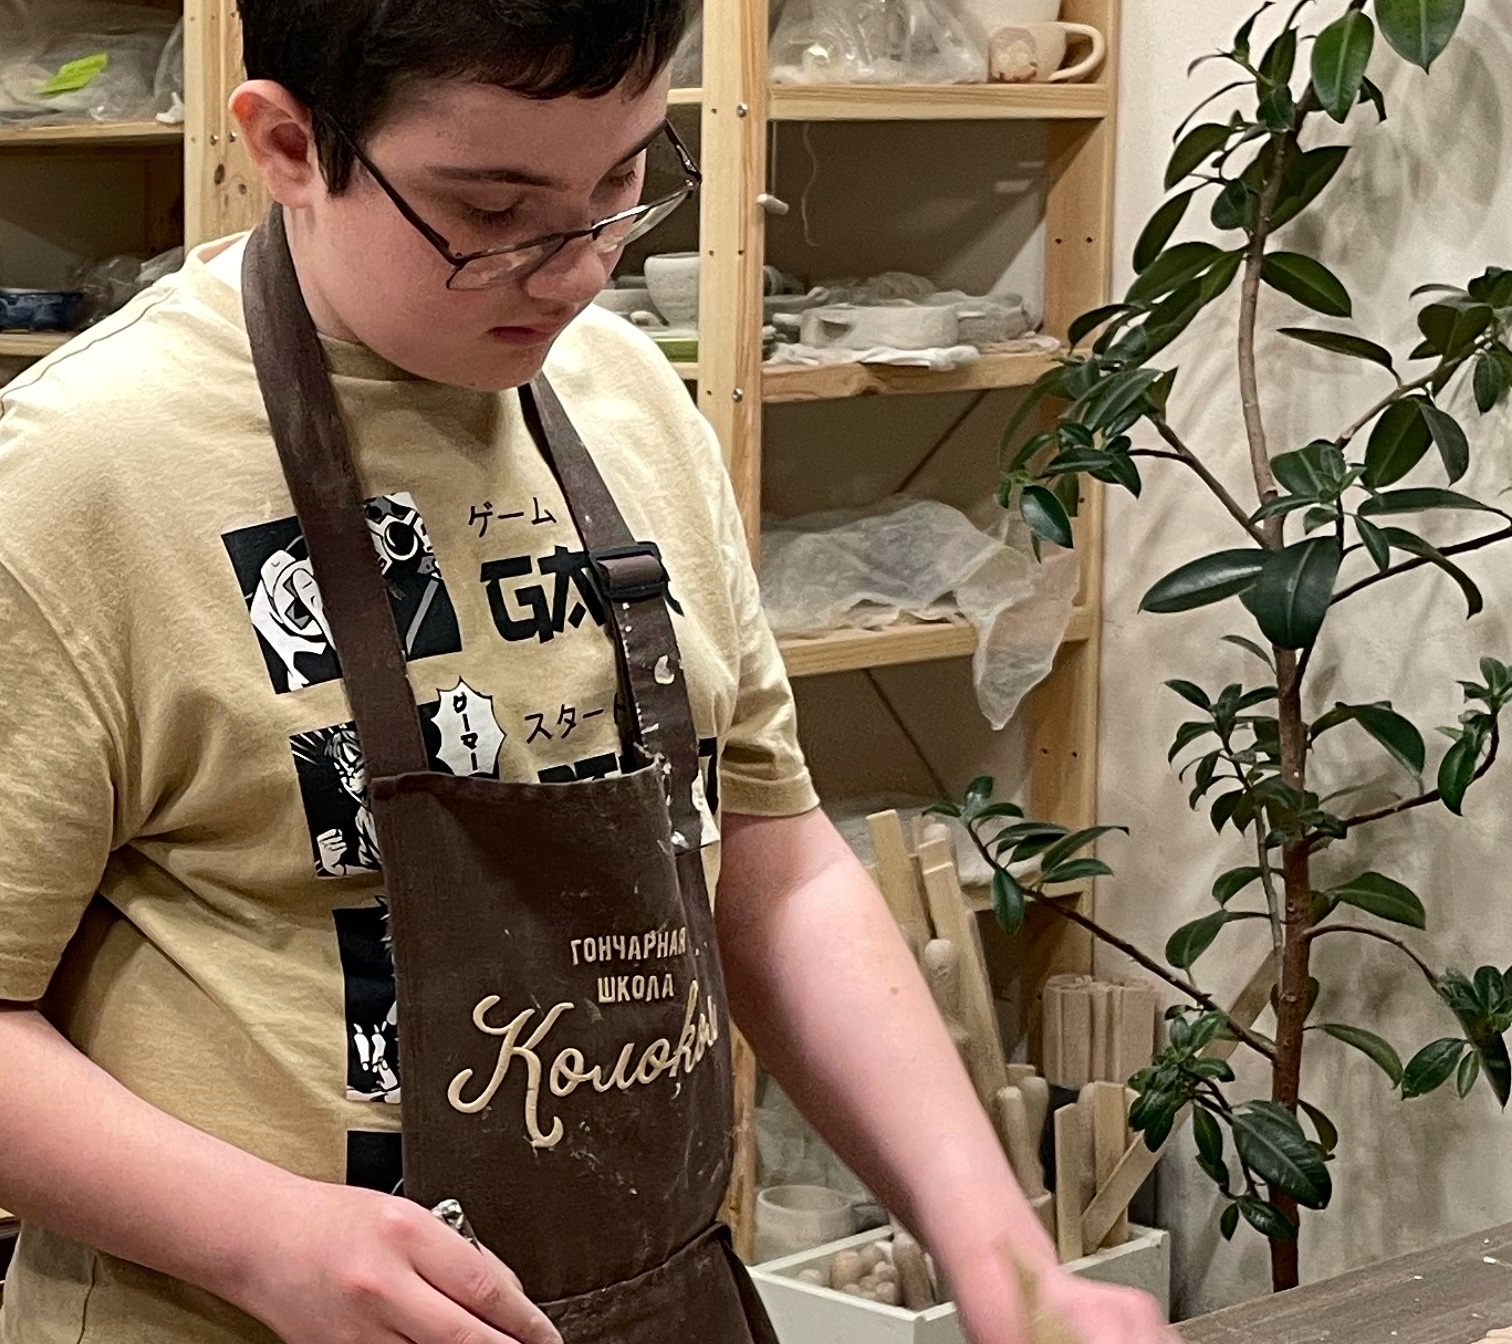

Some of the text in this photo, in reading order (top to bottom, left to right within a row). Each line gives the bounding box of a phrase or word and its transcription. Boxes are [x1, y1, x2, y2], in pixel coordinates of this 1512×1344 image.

[468, 497, 557, 538] ゲーム
[570, 926, 687, 966] ГОНЧАРНАЯ
[597, 973, 675, 1004] ШКОЛА
